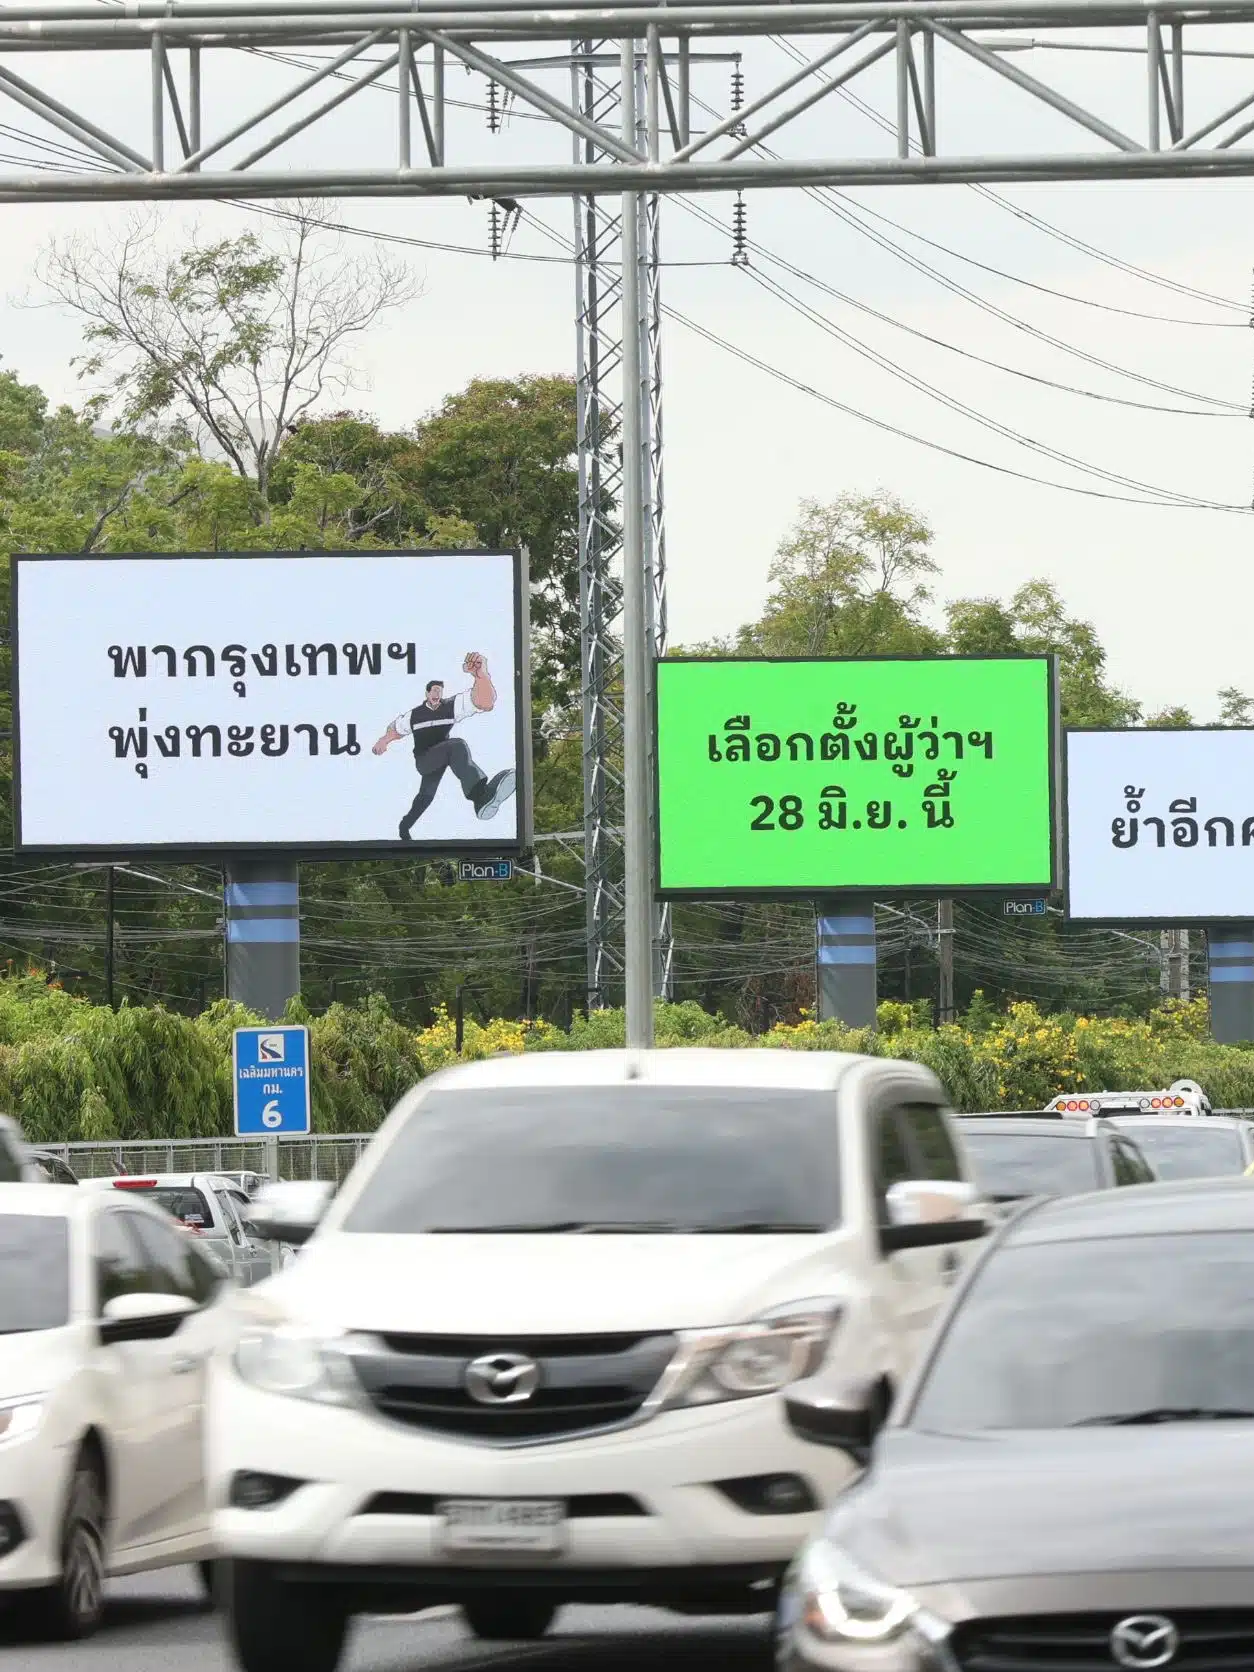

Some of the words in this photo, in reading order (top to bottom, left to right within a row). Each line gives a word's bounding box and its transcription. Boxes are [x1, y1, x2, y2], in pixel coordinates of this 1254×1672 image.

[107, 642, 417, 698] พากรุงเทพฯ
[108, 707, 361, 779] พุ่งทะยาน
[707, 701, 994, 778] เลือกตั้งผู้ว่าฯ
[749, 794, 804, 832] 28
[817, 785, 908, 831] มิ.ย.
[921, 768, 958, 830] นี้
[462, 863, 509, 877] Plan-B
[1006, 901, 1044, 913] Plan-B
[239, 1064, 304, 1079] เฉลิมมหานคร
[262, 1083, 283, 1095] กม.
[262, 1099, 282, 1129] 6
